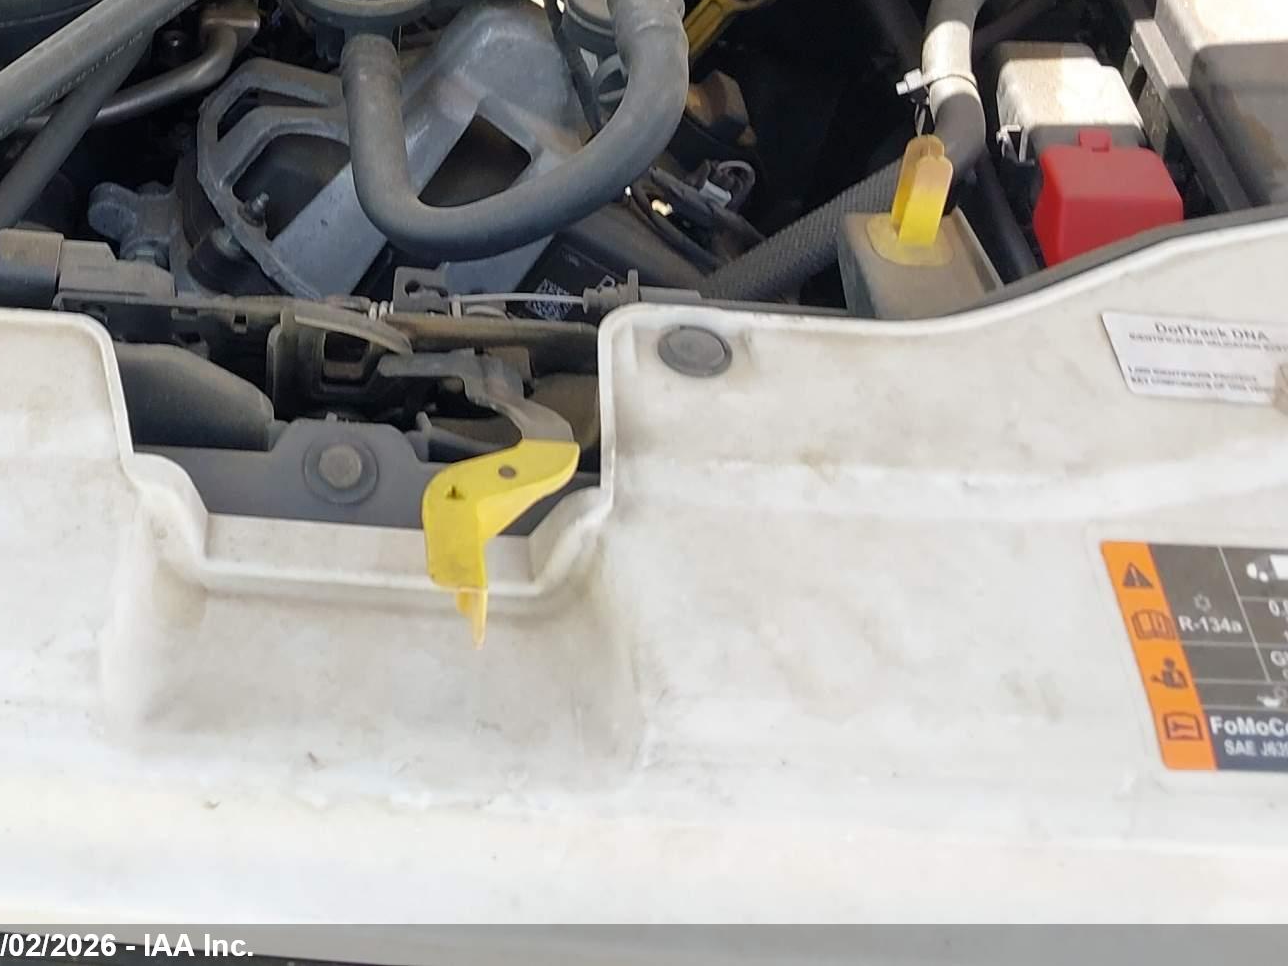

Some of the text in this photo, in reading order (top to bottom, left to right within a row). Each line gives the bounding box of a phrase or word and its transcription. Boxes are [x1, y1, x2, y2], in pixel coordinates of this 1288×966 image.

[1231, 330, 1270, 342] DNA
[1178, 615, 1243, 633] R-134a
[1209, 716, 1288, 737] FoMoC
[1224, 739, 1257, 756] SAE
